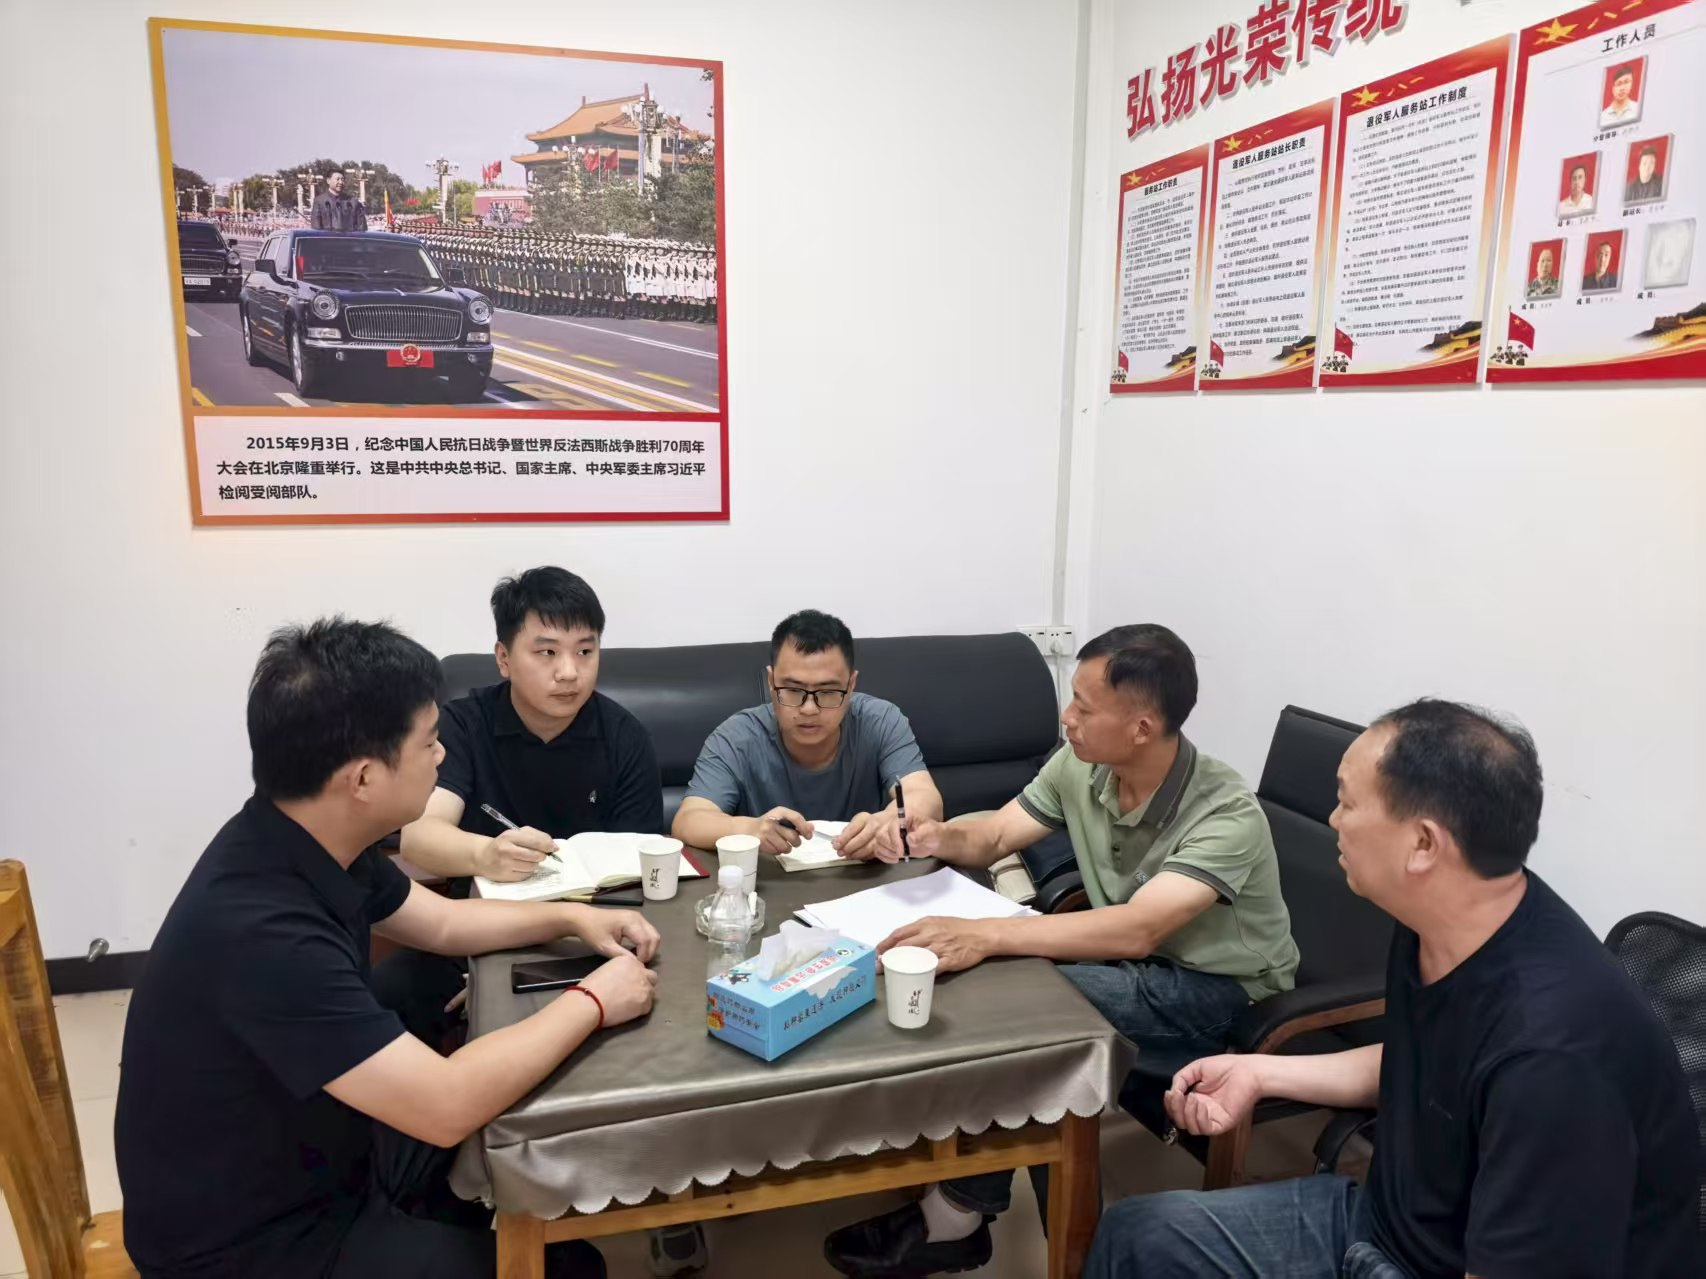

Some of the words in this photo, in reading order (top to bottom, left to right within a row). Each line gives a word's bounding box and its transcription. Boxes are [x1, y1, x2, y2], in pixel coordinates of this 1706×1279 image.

[1601, 23, 1657, 53] 工作人员
[1366, 86, 1468, 128] 退役军人服务站工作制度
[1232, 137, 1306, 170] 退役军人服务站站长职责
[246, 436, 705, 453] 2015年9月3日，纪念中国人民抗日战争暨世界反法西斯战争胜利70周年
[216, 460, 706, 476] 大会在北京隆重举行。这是中共中央总书记、国家主席、中央军委主席习近平
[218, 484, 319, 500] 检阅受阅部队。
